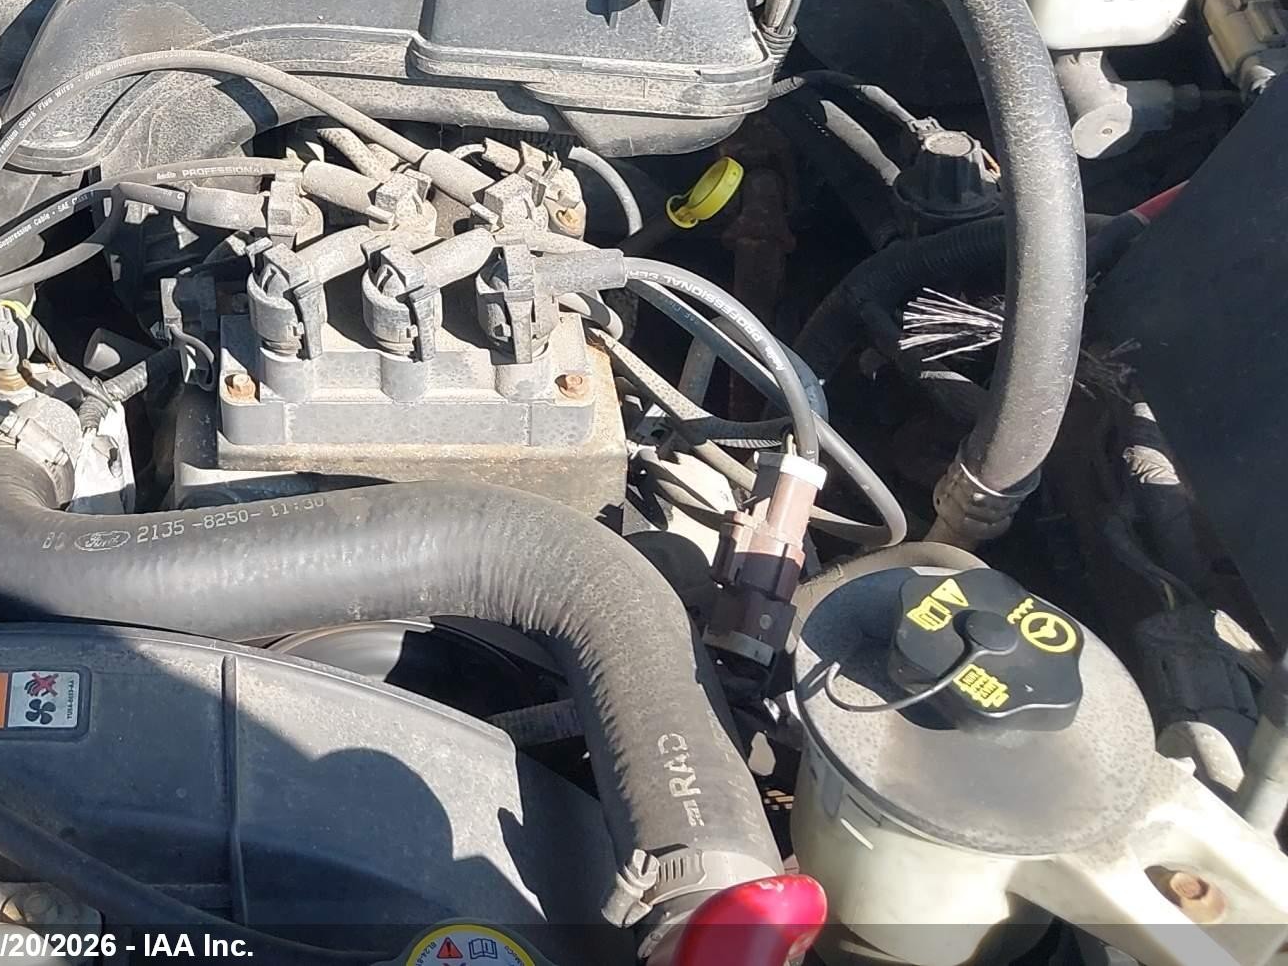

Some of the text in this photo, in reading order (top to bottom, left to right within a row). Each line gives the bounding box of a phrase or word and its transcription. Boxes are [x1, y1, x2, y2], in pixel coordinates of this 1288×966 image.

[18, 109, 37, 130] Spark
[37, 96, 54, 112] Plug
[54, 82, 76, 99] Wires
[181, 165, 263, 178] PROFESSIONAL
[33, 212, 51, 228] Cable
[57, 201, 70, 213] SAE
[664, 274, 763, 343] PROFESSIONAL
[657, 733, 702, 798] RAD
